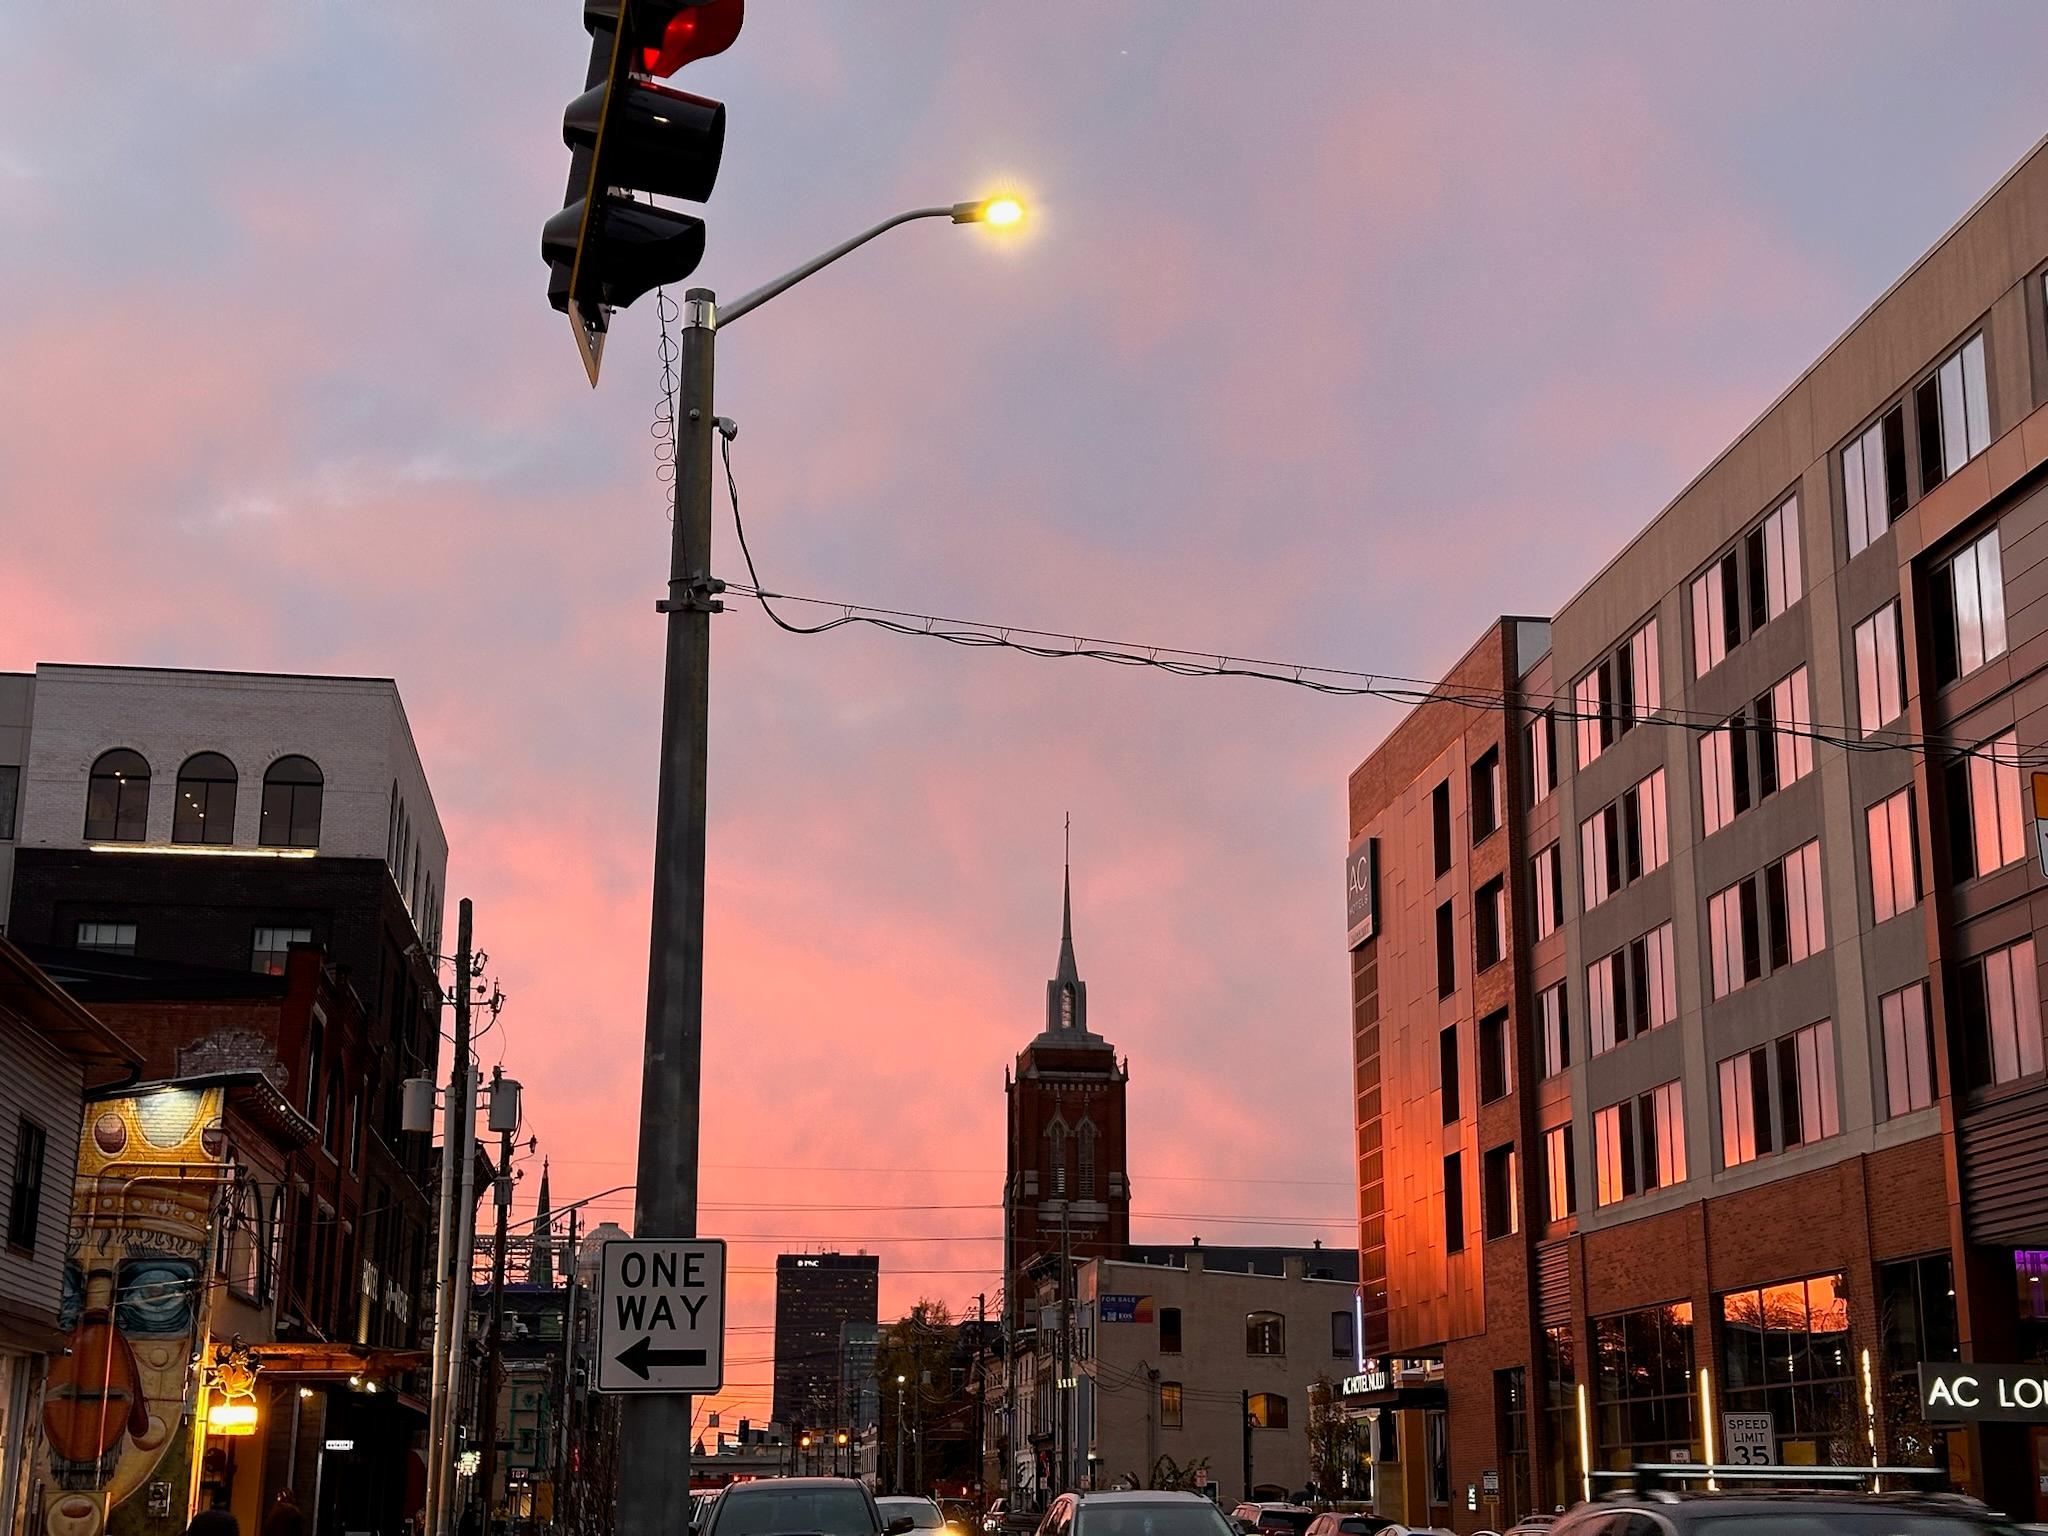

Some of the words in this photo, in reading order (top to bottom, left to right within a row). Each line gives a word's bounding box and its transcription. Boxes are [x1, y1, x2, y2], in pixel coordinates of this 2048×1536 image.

[1349, 856, 1367, 900] AC
[621, 1252, 705, 1289] ONE
[616, 1295, 708, 1331] WAY
[1343, 1377, 1351, 1395] AC
[1351, 1374, 1368, 1393] HOTEL
[1368, 1371, 1385, 1391] NULU
[1928, 1376, 1980, 1407] AC
[1729, 1420, 1768, 1429] SPEED
[1734, 1433, 1765, 1442] LIMIT
[1734, 1446, 1770, 1465] 35
